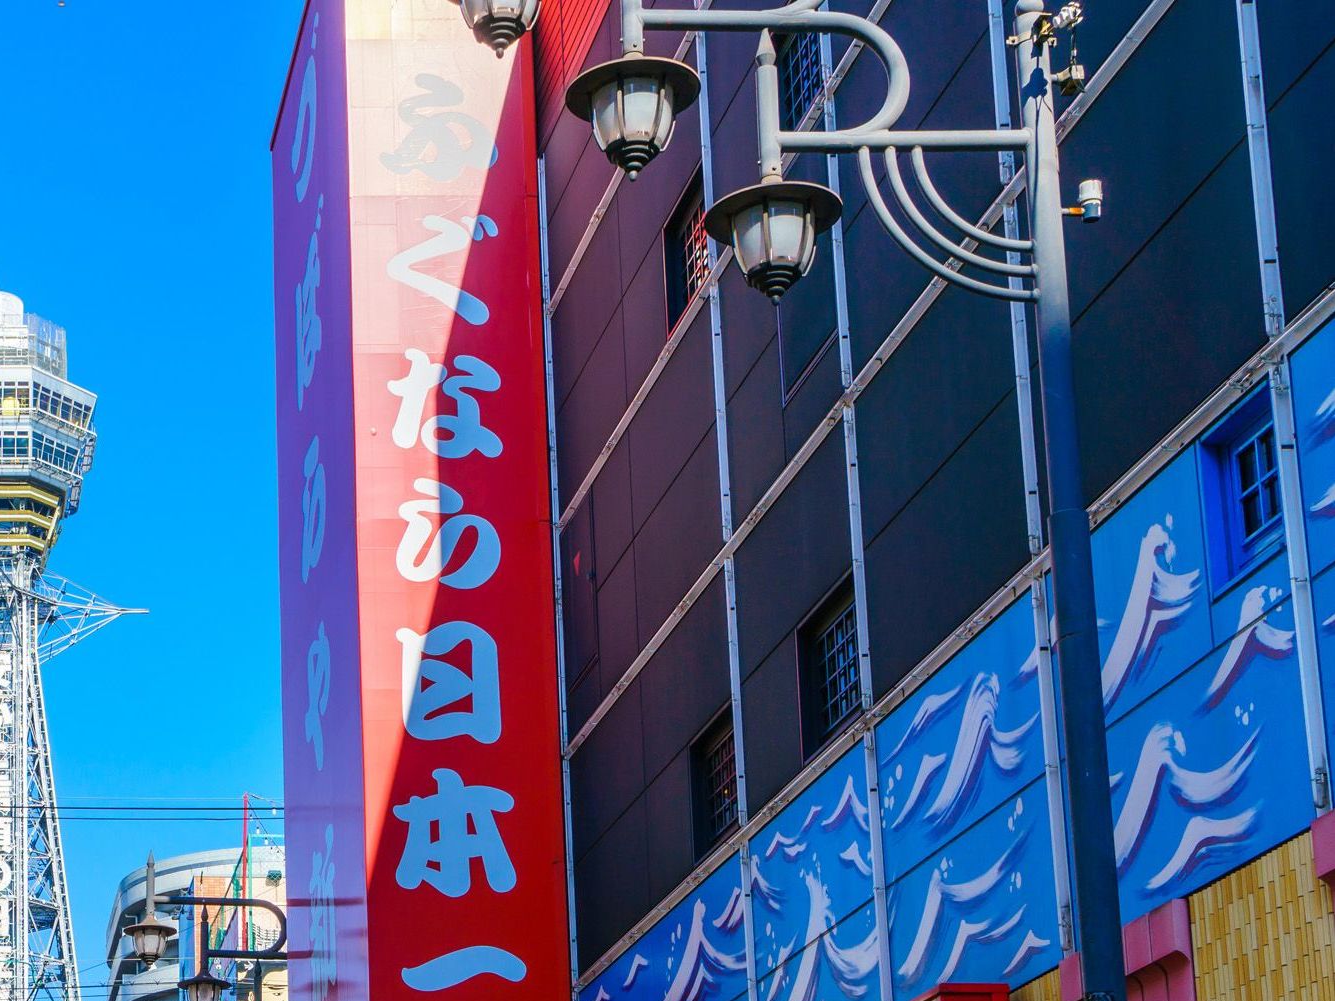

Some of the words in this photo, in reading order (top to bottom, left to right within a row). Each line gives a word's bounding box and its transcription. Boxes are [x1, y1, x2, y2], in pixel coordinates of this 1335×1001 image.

[380, 73, 527, 991] ふぐなら日本一
